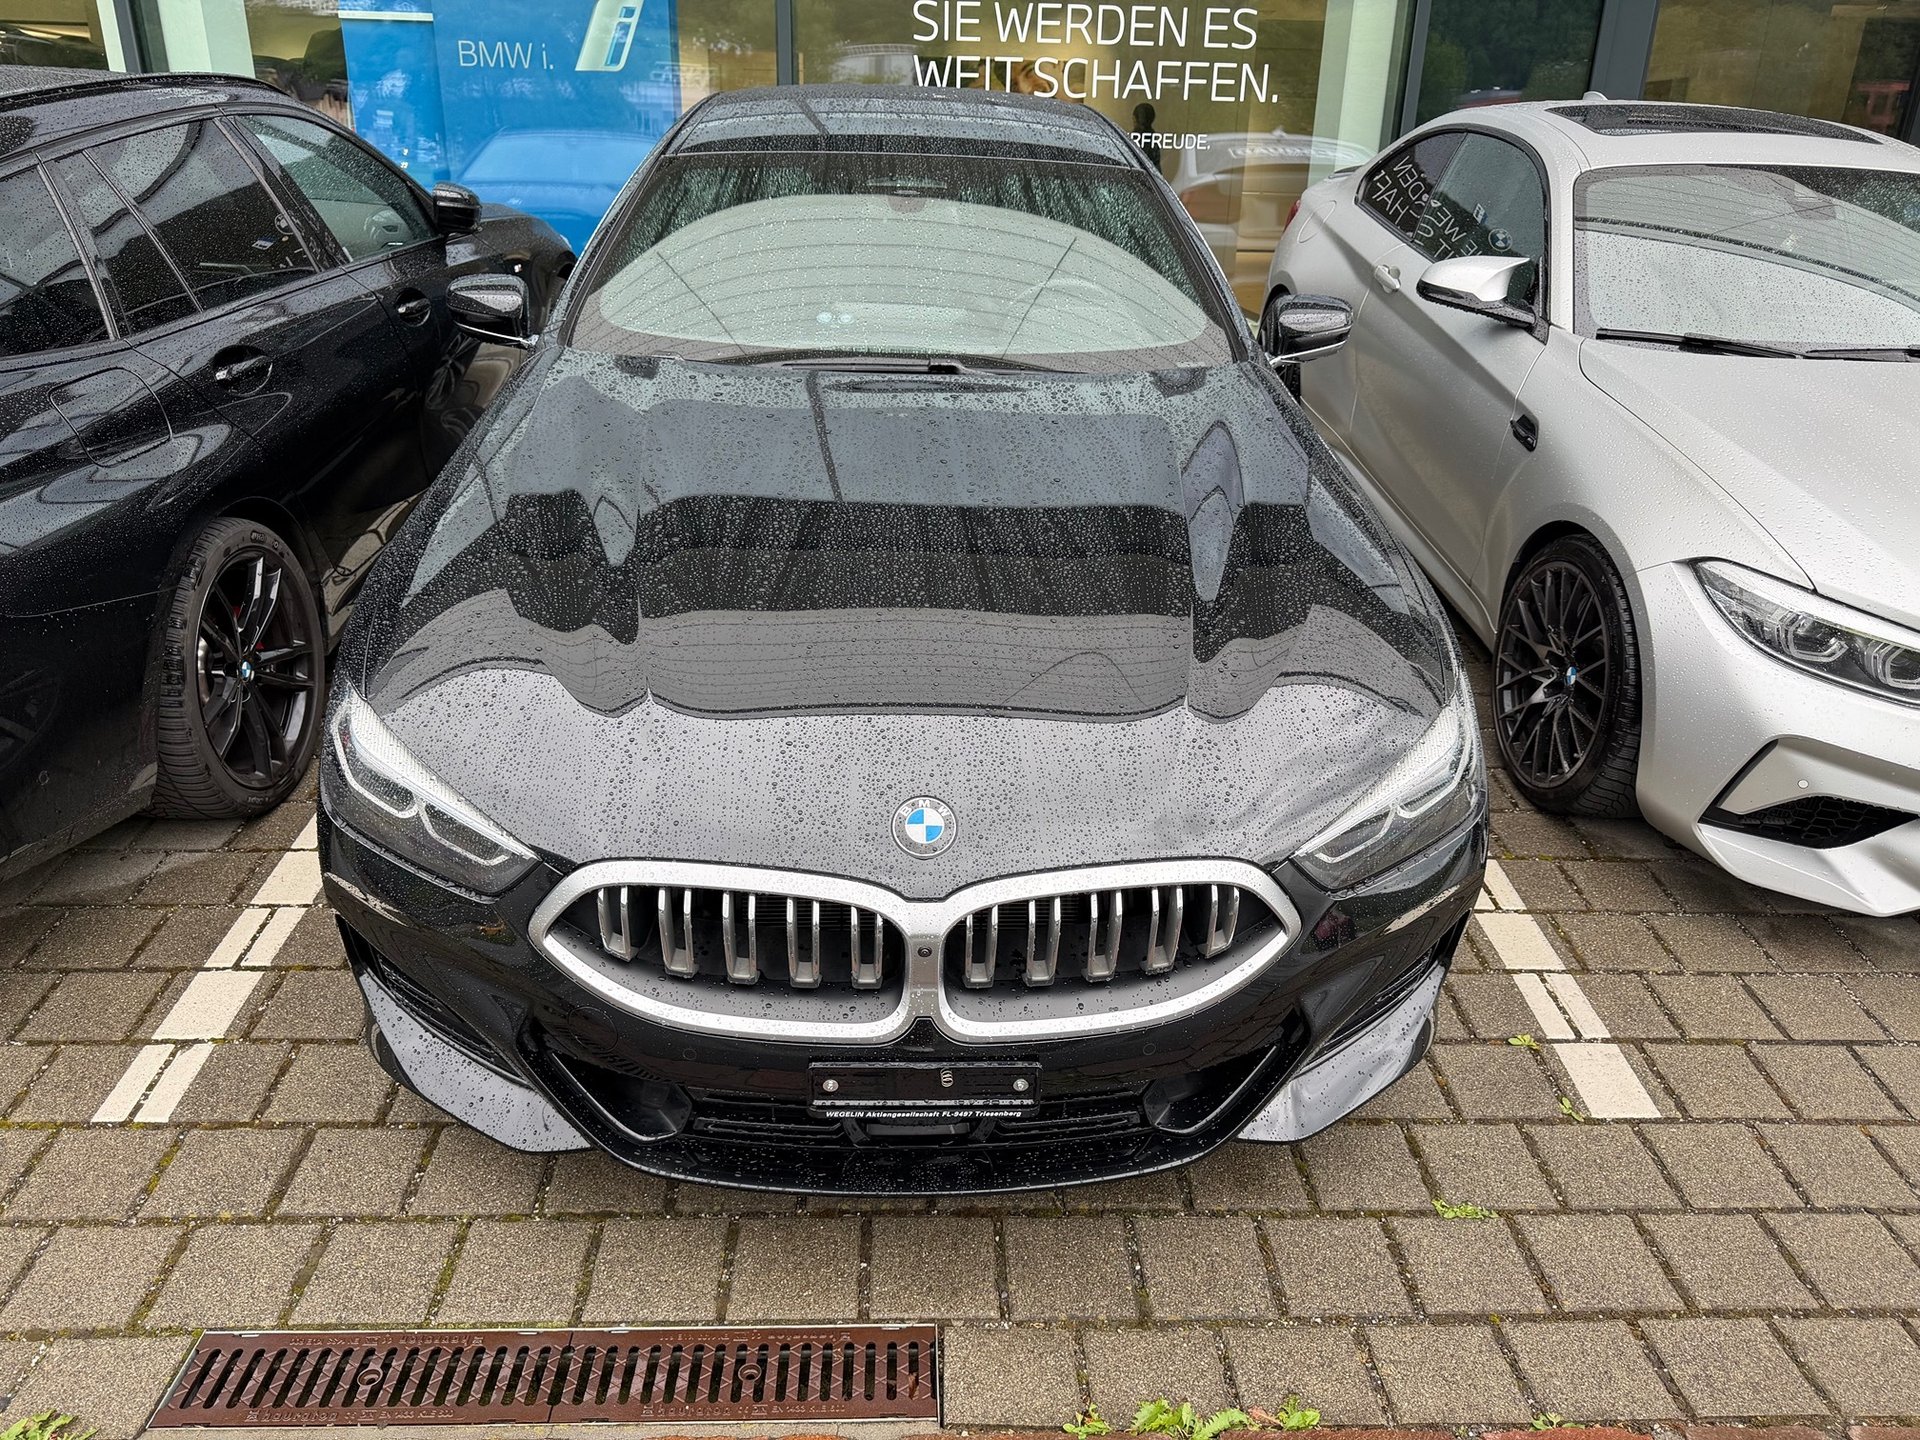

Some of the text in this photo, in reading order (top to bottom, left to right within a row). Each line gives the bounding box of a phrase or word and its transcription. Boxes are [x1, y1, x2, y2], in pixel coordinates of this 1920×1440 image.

[912, 0, 1258, 50] SIE WERDEN ES
[457, 39, 555, 70] BMW i.
[912, 54, 1279, 104] WEIT SCHAFFEN.
[1127, 132, 1211, 150] RFREUDE.
[899, 799, 951, 817] BMW
[866, 1111, 940, 1119] Aktiengesellschaft
